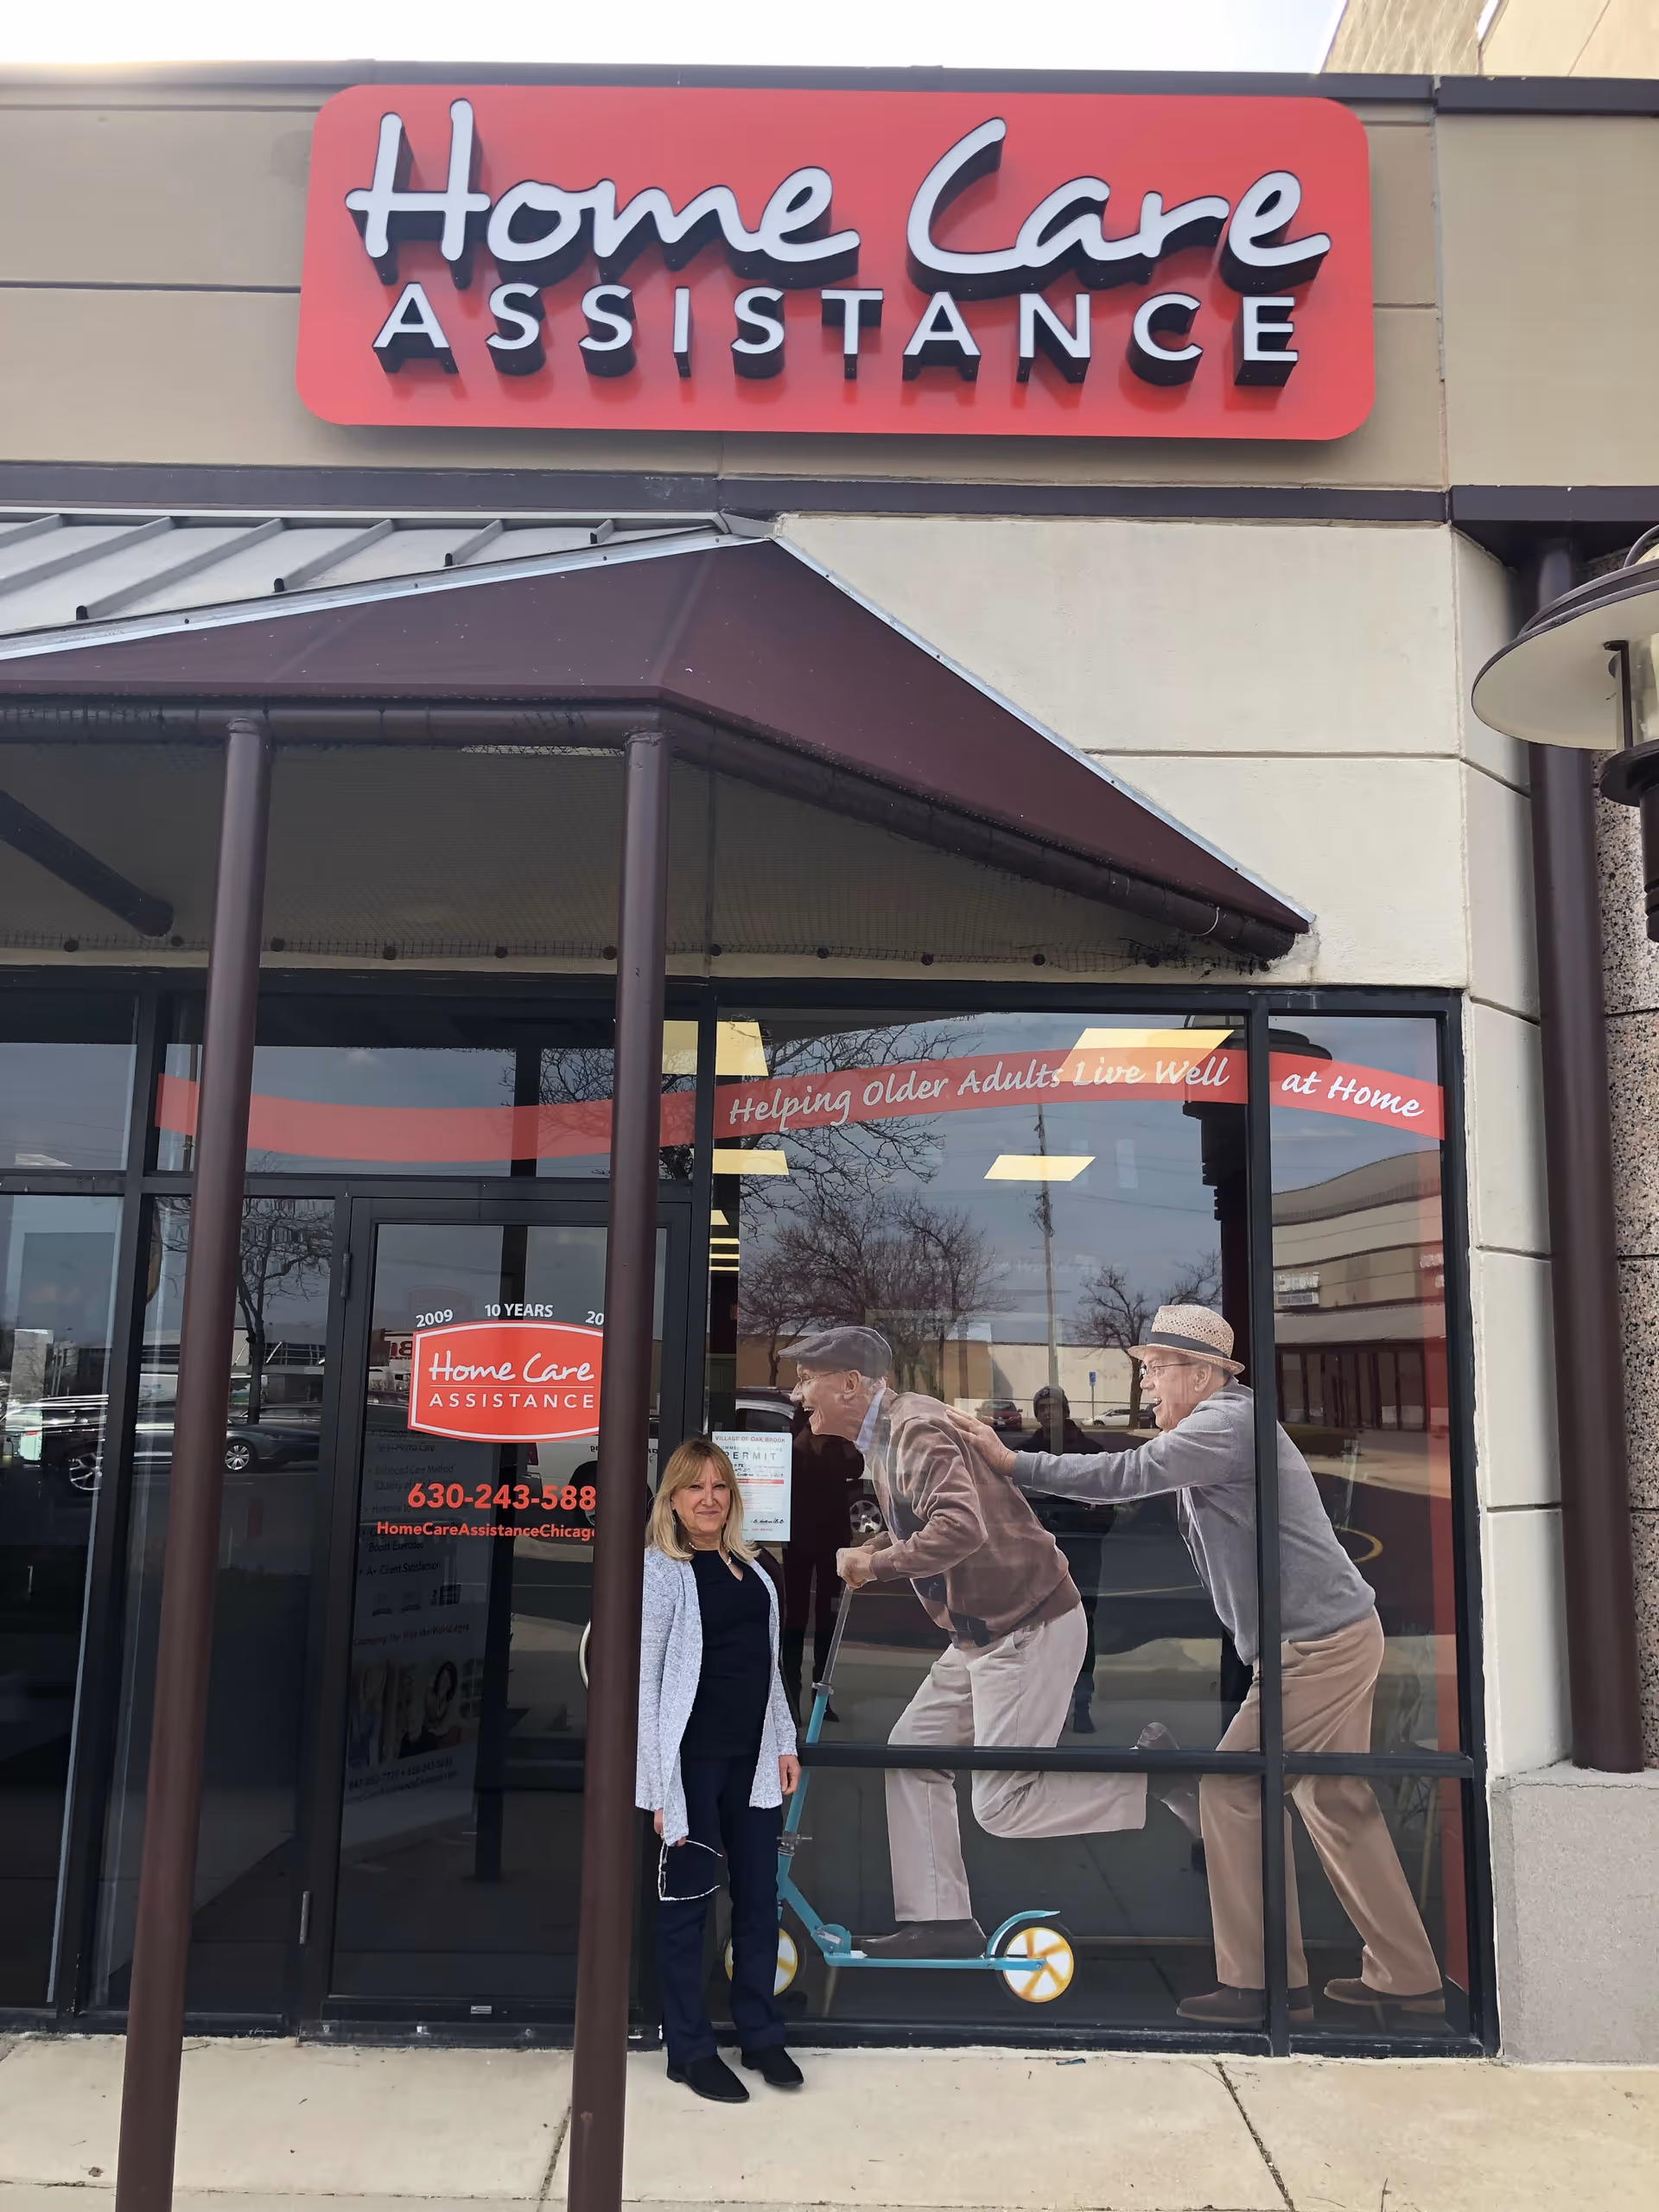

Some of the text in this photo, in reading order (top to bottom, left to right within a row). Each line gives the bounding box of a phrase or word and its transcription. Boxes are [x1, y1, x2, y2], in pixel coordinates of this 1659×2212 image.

[346, 99, 1332, 275] Home Care
[372, 282, 1300, 363] ASSISTANCE
[728, 1053, 1427, 1133] Helping Older Adults Live Well at Home
[415, 1308, 454, 1328] 2009
[484, 1303, 501, 1318] 10
[504, 1303, 554, 1318] YEARS
[429, 1350, 517, 1382] Home
[522, 1352, 595, 1383] Care
[429, 1393, 594, 1408] ASSISTANCE
